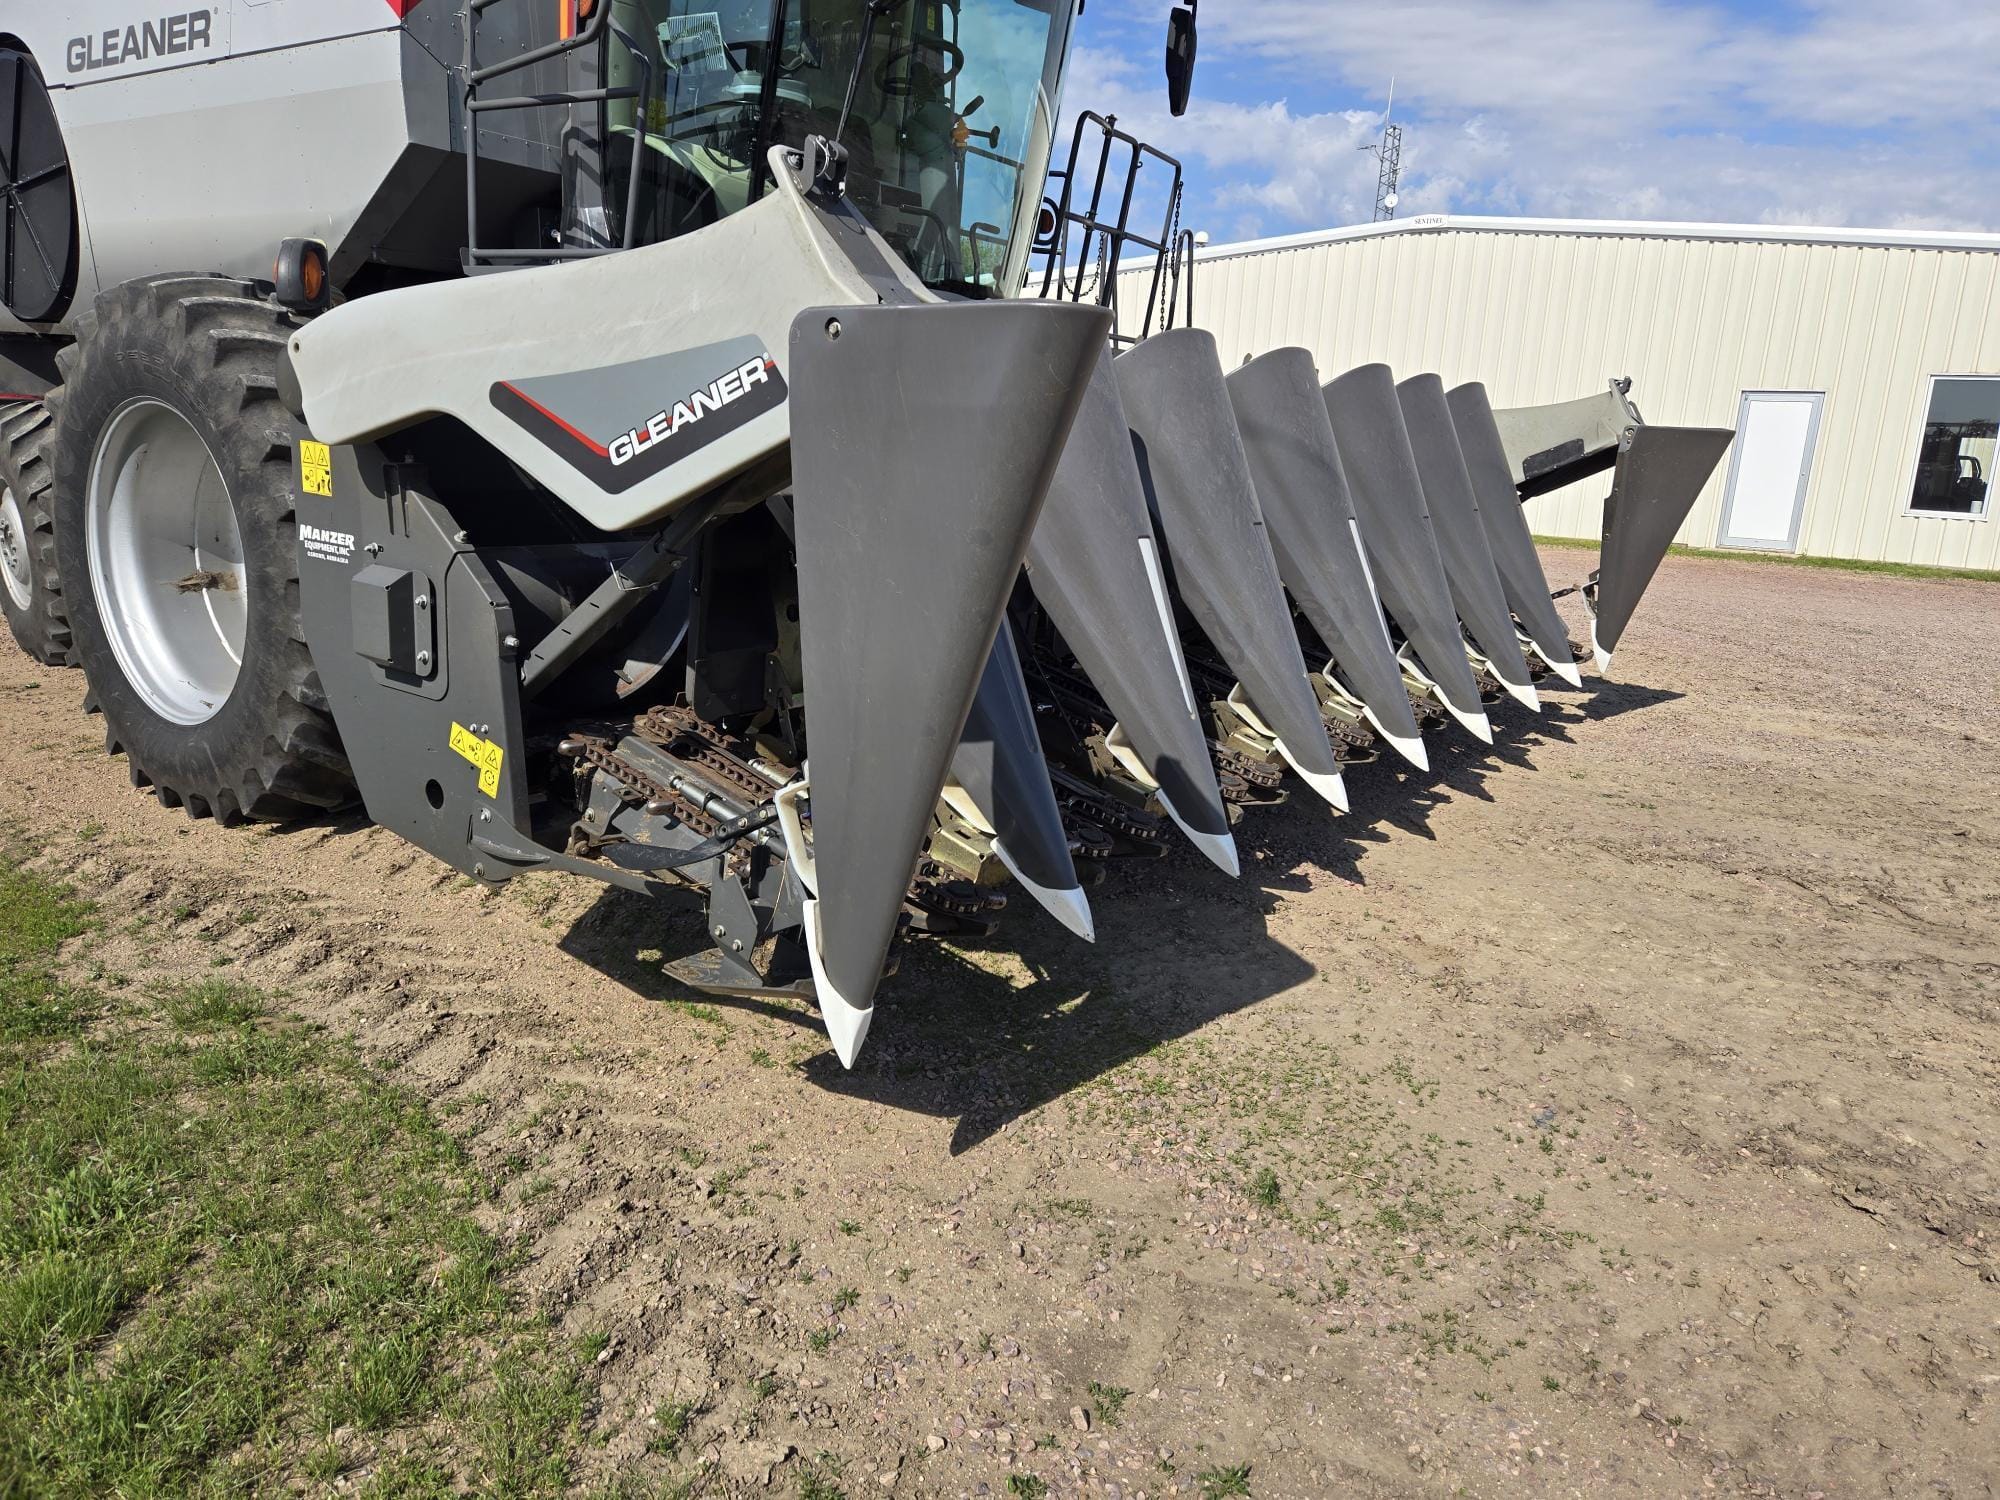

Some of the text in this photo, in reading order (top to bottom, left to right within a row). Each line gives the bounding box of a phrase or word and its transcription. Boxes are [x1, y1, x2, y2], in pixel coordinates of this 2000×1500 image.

[66, 9, 211, 73] GLEANER
[608, 355, 769, 467] GLEANER
[299, 524, 355, 551] MANZER
